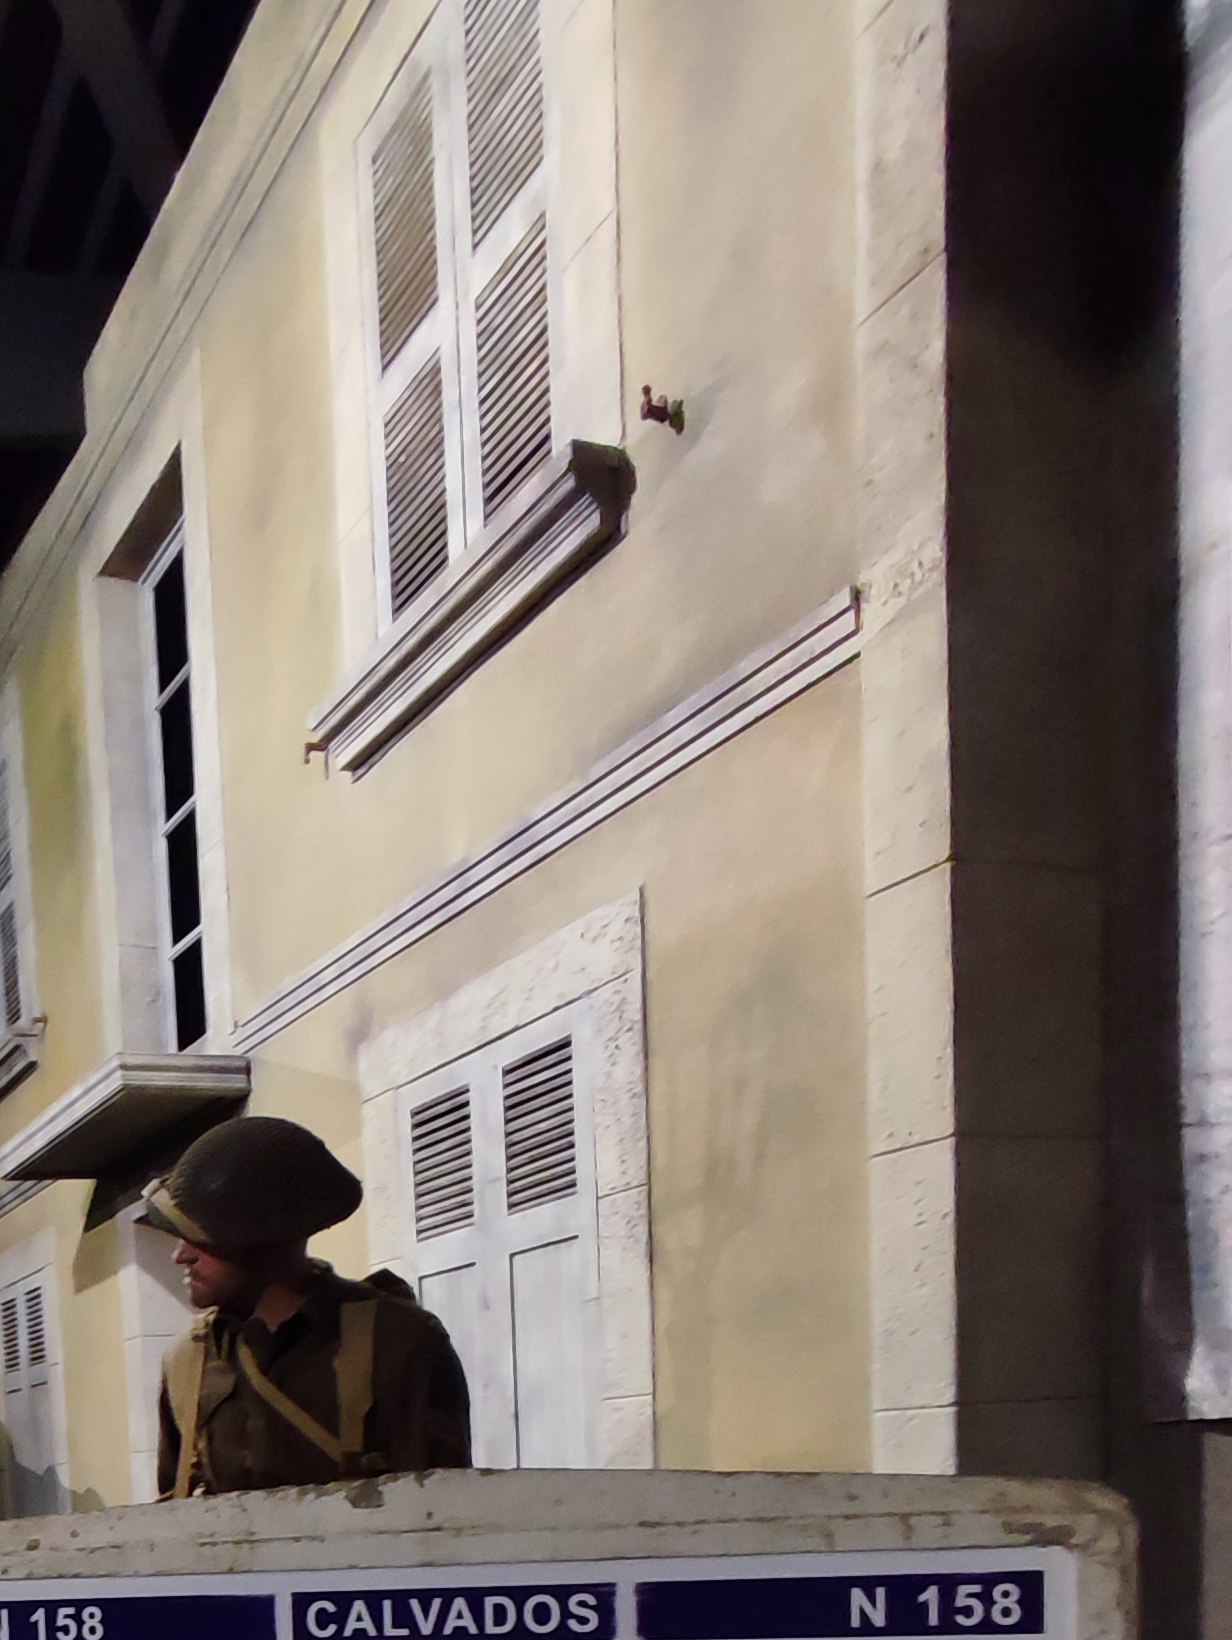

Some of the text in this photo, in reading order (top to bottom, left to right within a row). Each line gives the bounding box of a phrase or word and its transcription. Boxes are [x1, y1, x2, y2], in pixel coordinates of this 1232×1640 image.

[305, 1592, 601, 1638] CALVADOS
[850, 1583, 1022, 1628] N 158
